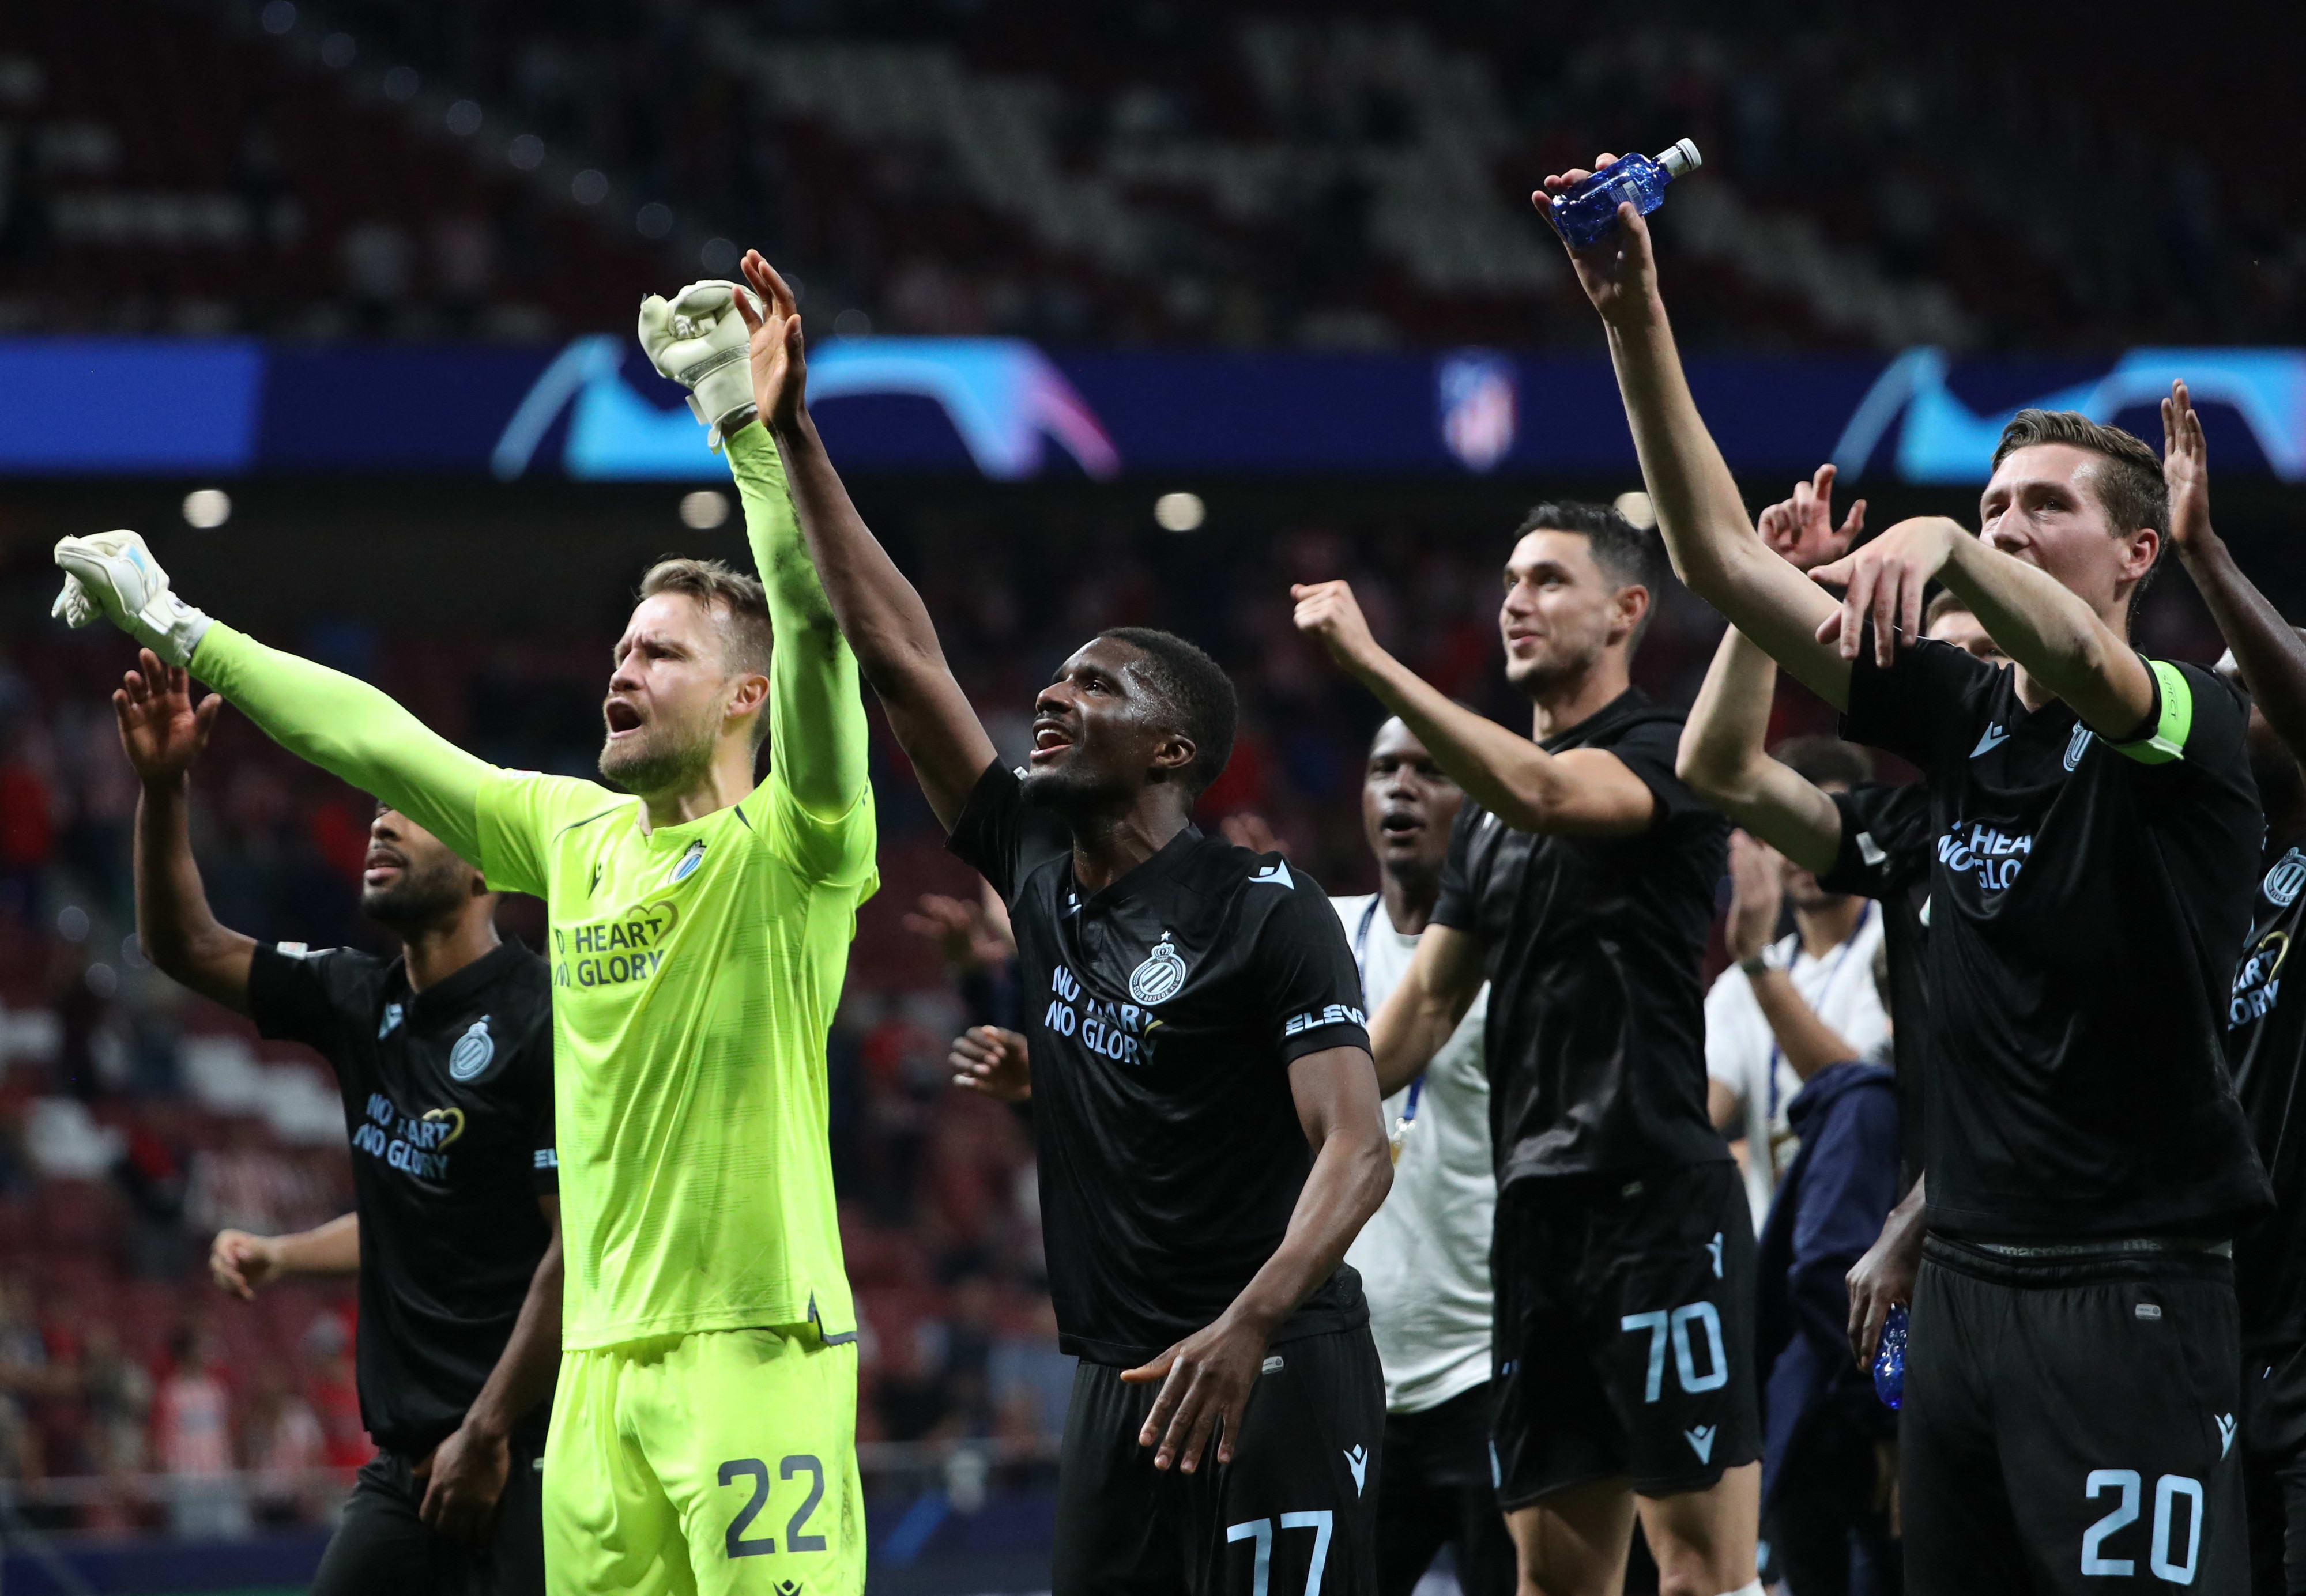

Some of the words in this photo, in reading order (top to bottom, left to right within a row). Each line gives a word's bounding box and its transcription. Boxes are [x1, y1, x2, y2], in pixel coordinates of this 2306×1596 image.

[576, 918, 662, 953] HEART
[578, 949, 664, 987] GLORY
[1133, 985, 1144, 998] CLUB
[1144, 990, 1170, 1001] BRUGGE
[1170, 982, 1178, 991] KV
[1045, 999, 1076, 1036] NO
[1082, 1018, 1158, 1066] GLORY
[2228, 979, 2279, 1032] ORY
[366, 1093, 393, 1126] NO
[352, 1123, 386, 1158] NO
[387, 1139, 448, 1179] GLORY
[1621, 1301, 1728, 1403] 70
[718, 1454, 826, 1559] 22
[2081, 1469, 2203, 1586] 20
[1227, 1510, 1333, 1596] 77
